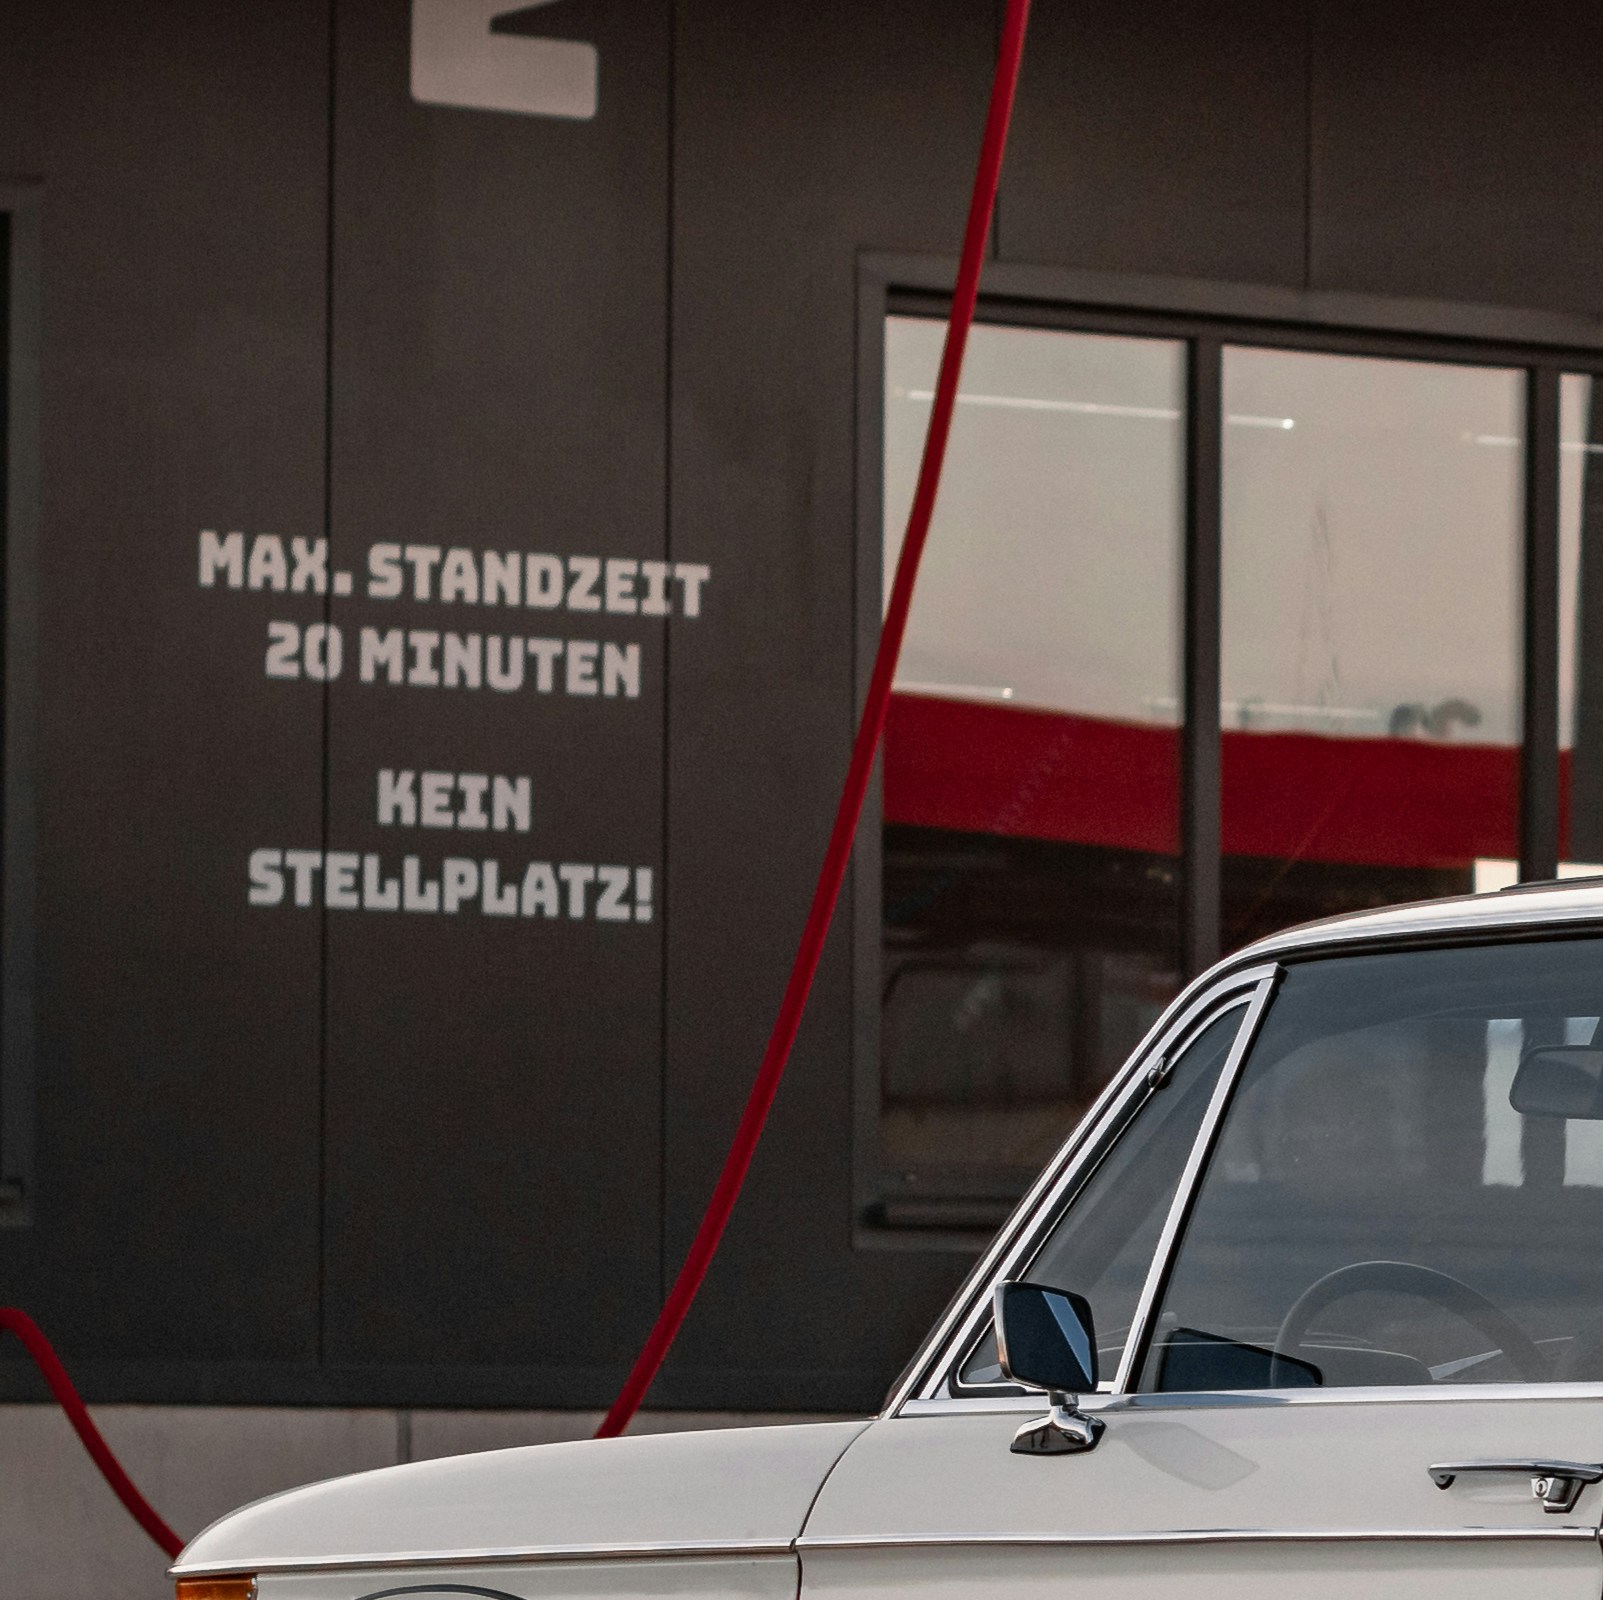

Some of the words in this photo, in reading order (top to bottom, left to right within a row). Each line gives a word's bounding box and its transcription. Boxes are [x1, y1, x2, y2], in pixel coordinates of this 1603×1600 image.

[200, 531, 352, 595] MAX.
[368, 543, 710, 617] STANDZEIT
[266, 622, 342, 680] 20
[360, 628, 640, 697] MINUTEN
[378, 770, 530, 831] KEIN
[249, 850, 652, 921] STELLPLATZ!
